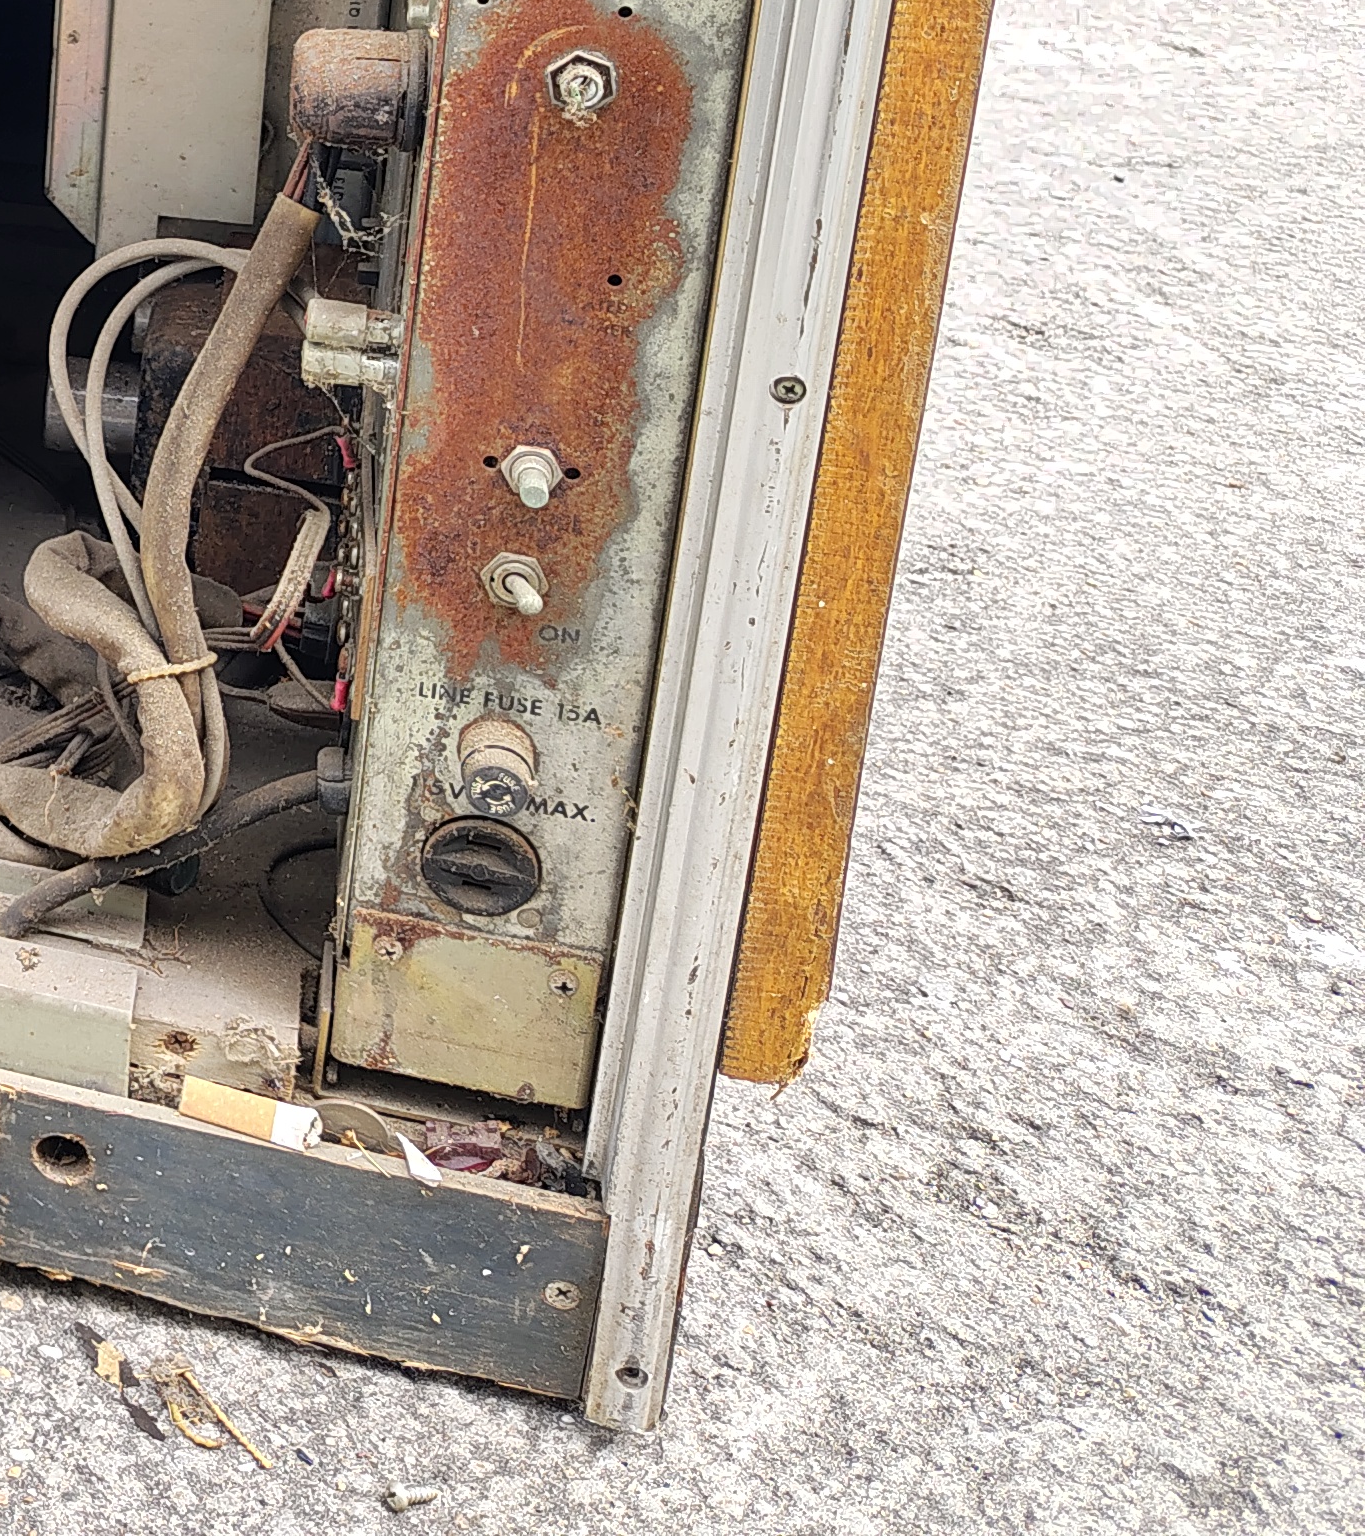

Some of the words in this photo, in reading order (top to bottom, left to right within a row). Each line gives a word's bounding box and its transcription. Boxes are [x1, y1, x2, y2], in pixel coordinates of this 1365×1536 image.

[538, 624, 581, 644] ON
[418, 681, 471, 706] LINE
[483, 692, 543, 715] FUSE
[557, 702, 603, 726] 15A
[471, 776, 485, 798] FUSE
[498, 772, 521, 792] FUSE
[489, 802, 515, 814] FUSE
[525, 796, 596, 824] MAX.
